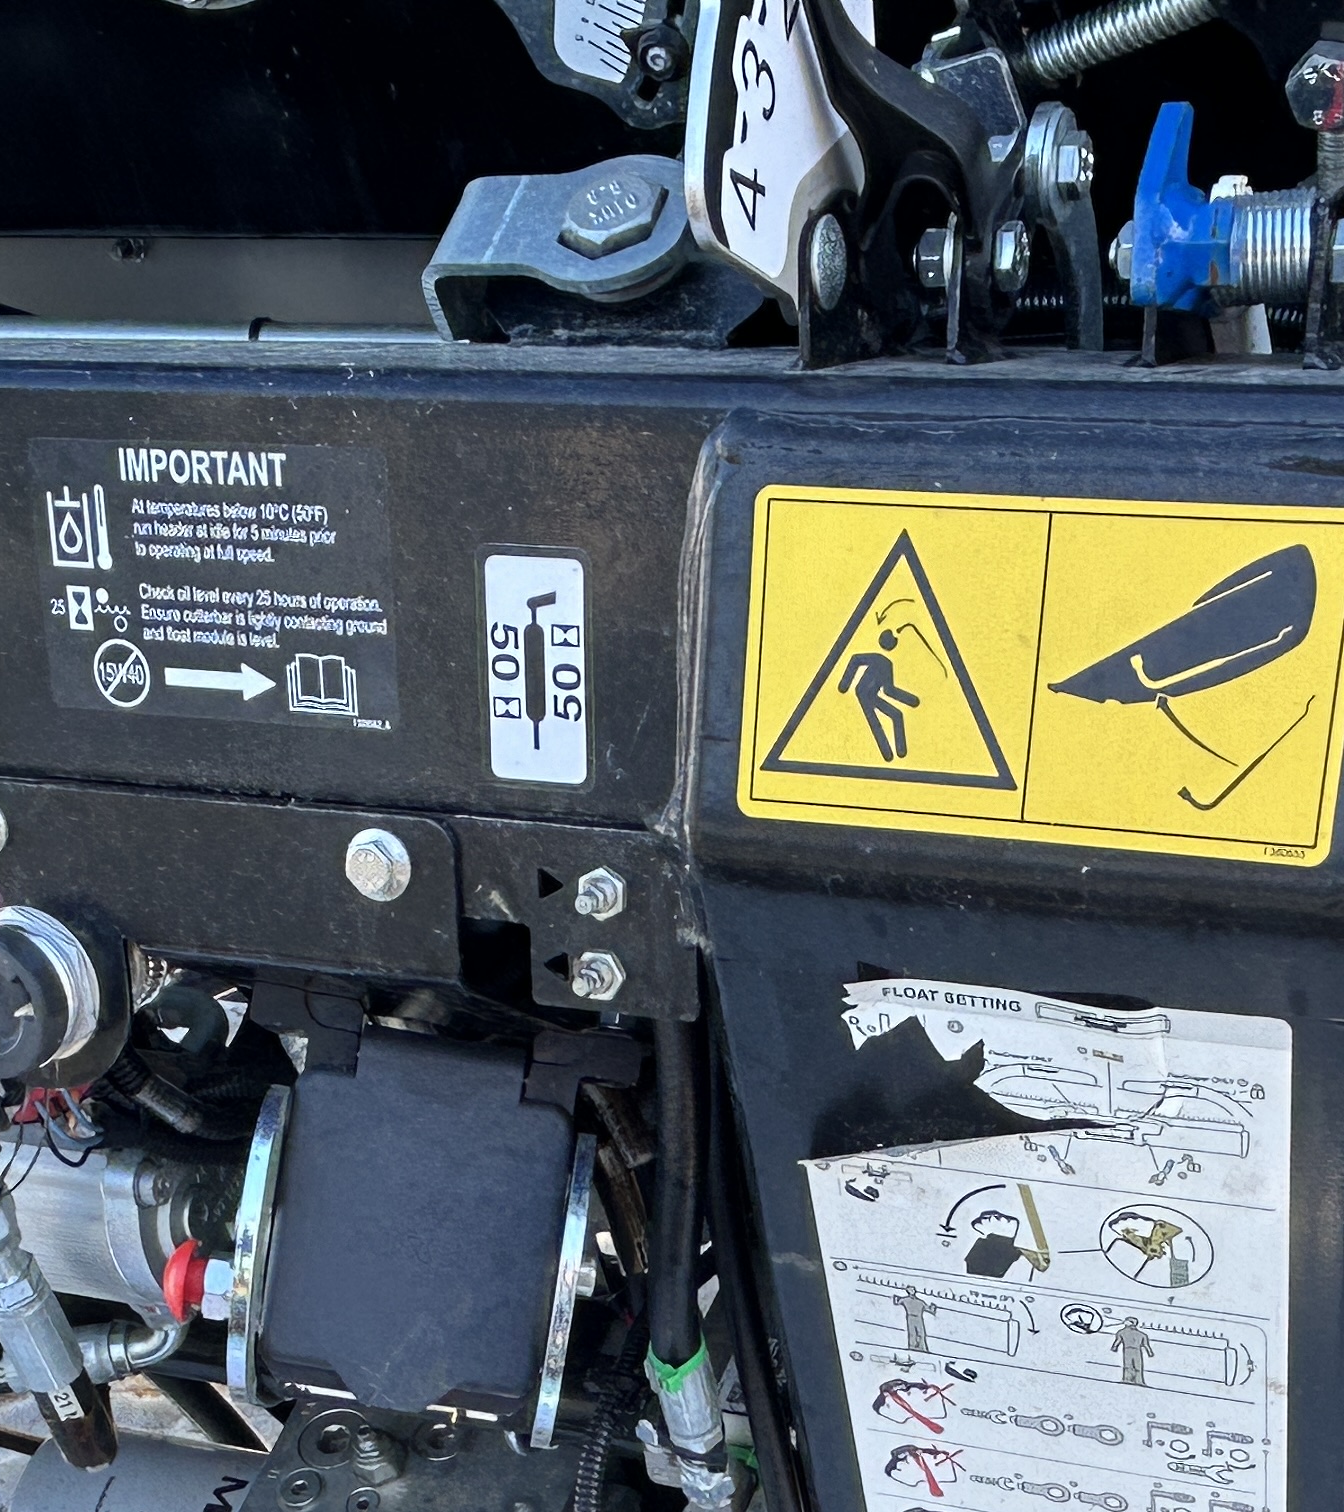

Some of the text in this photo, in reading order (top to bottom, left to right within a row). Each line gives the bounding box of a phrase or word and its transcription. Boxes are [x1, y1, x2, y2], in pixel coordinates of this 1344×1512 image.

[730, 39, 776, 231] 4 3
[118, 447, 287, 487] IMPORTANT
[146, 499, 221, 519] temperatures
[154, 520, 194, 538] header
[250, 523, 260, 541] 5
[261, 525, 307, 544] minutes
[309, 527, 337, 547] prior
[149, 542, 201, 563] operating
[138, 582, 175, 602] Check
[193, 586, 220, 604] level
[222, 590, 254, 608] every
[256, 588, 272, 606] 25
[273, 590, 307, 609] hours
[141, 603, 181, 622] Ensure
[345, 618, 388, 636] ground
[490, 621, 520, 682] 50
[551, 662, 583, 722] 50
[882, 986, 1022, 1013] FLOAT SETTING
